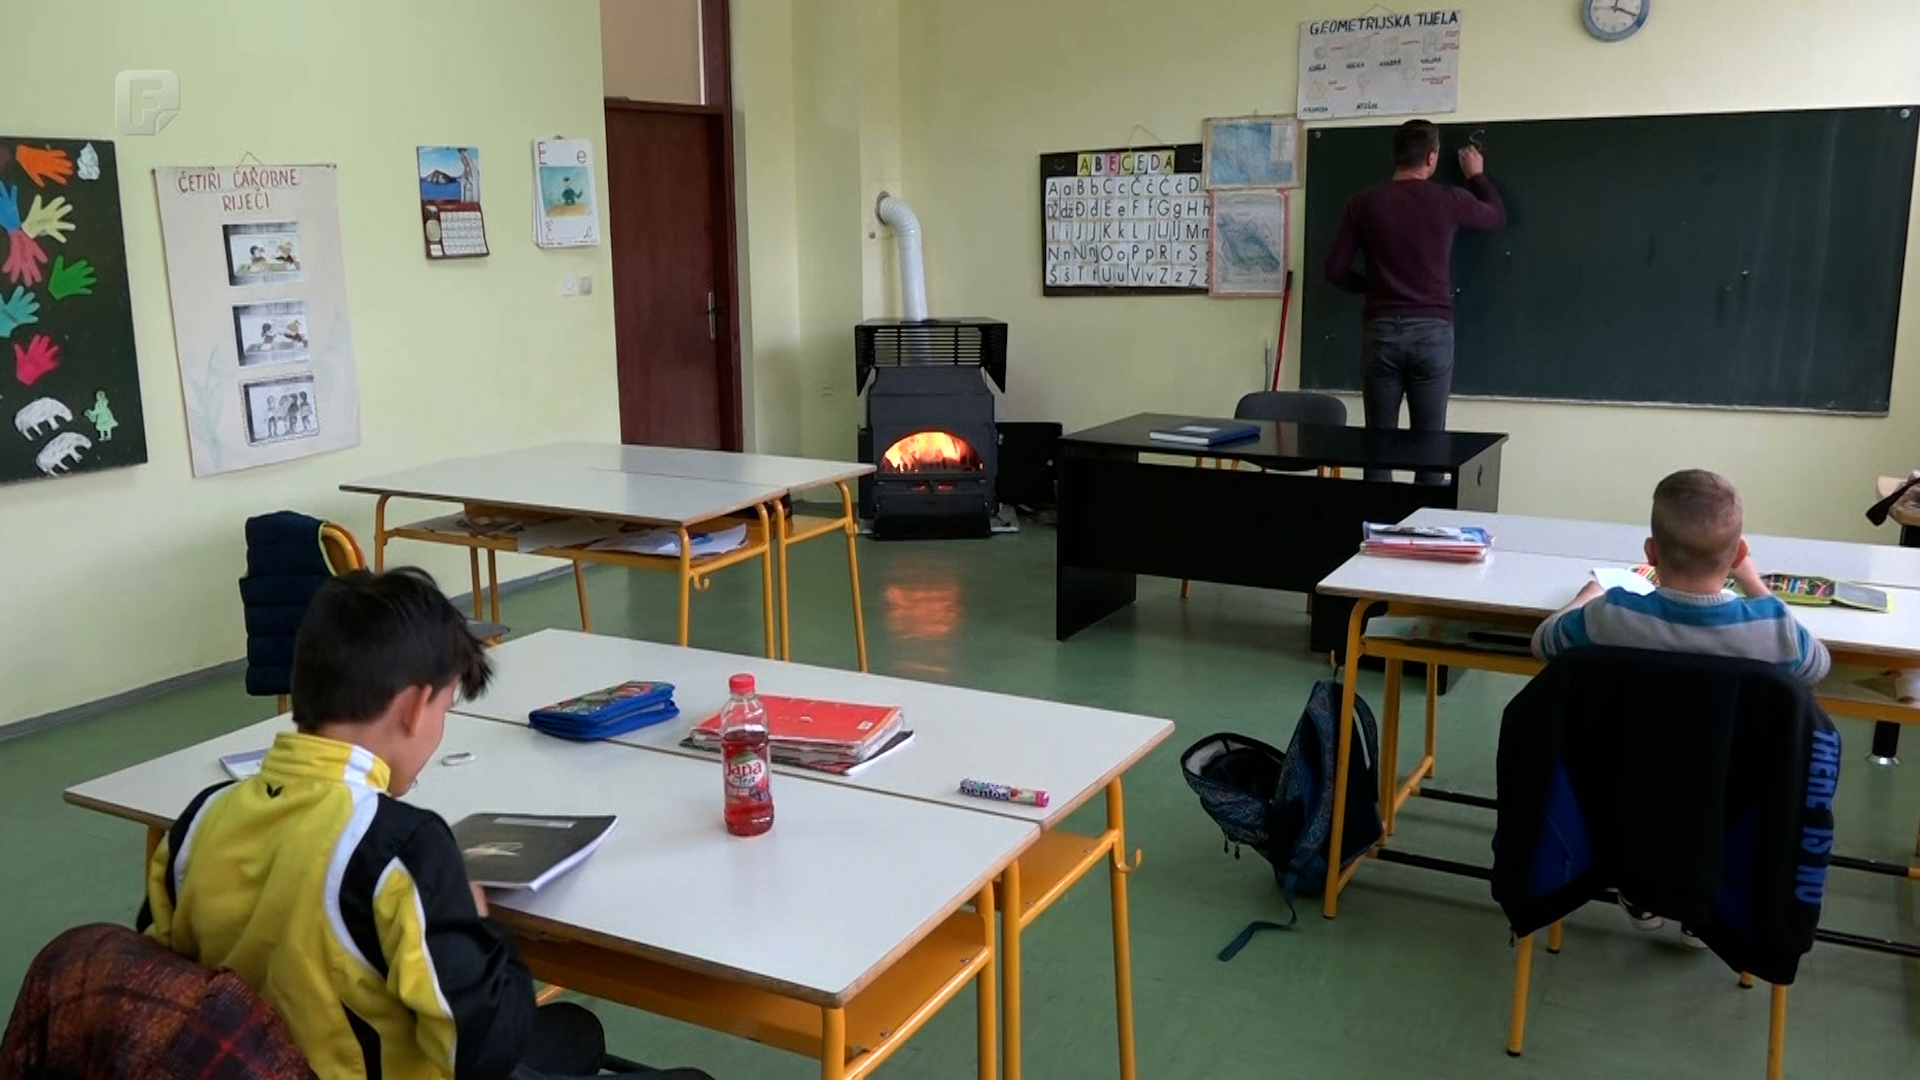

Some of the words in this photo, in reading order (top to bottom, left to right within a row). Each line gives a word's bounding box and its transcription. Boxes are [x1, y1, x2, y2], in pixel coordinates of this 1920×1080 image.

[1310, 14, 1411, 35] GEOMETRIJSKA
[1415, 10, 1459, 27] TIJELA
[538, 141, 547, 165] E
[576, 150, 587, 164] e
[1079, 153, 1173, 173] ABECEDA
[178, 171, 221, 193] ČETIRI
[222, 188, 270, 212] RIJEČI
[727, 762, 762, 776] Jana
[1806, 731, 1839, 809] THERE
[1802, 827, 1833, 853] IS
